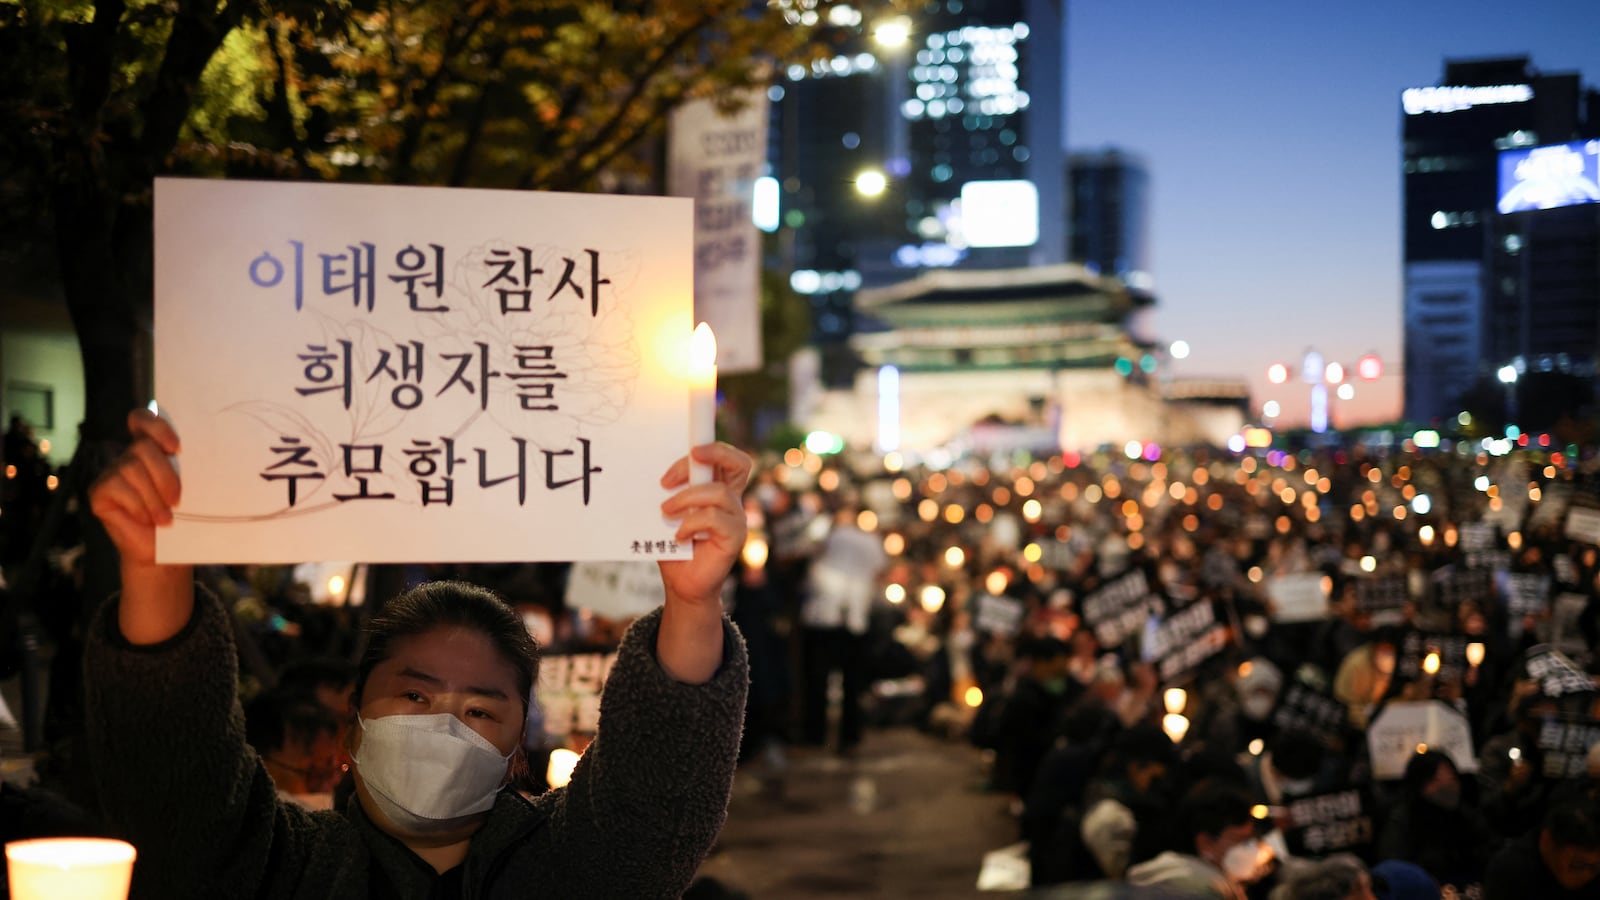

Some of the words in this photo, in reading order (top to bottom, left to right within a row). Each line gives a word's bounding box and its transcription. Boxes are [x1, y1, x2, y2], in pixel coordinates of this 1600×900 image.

[248, 240, 450, 314] 이태원
[482, 245, 611, 317] 참사
[294, 339, 569, 411] 희생자를
[259, 436, 603, 507] 추모합니다
